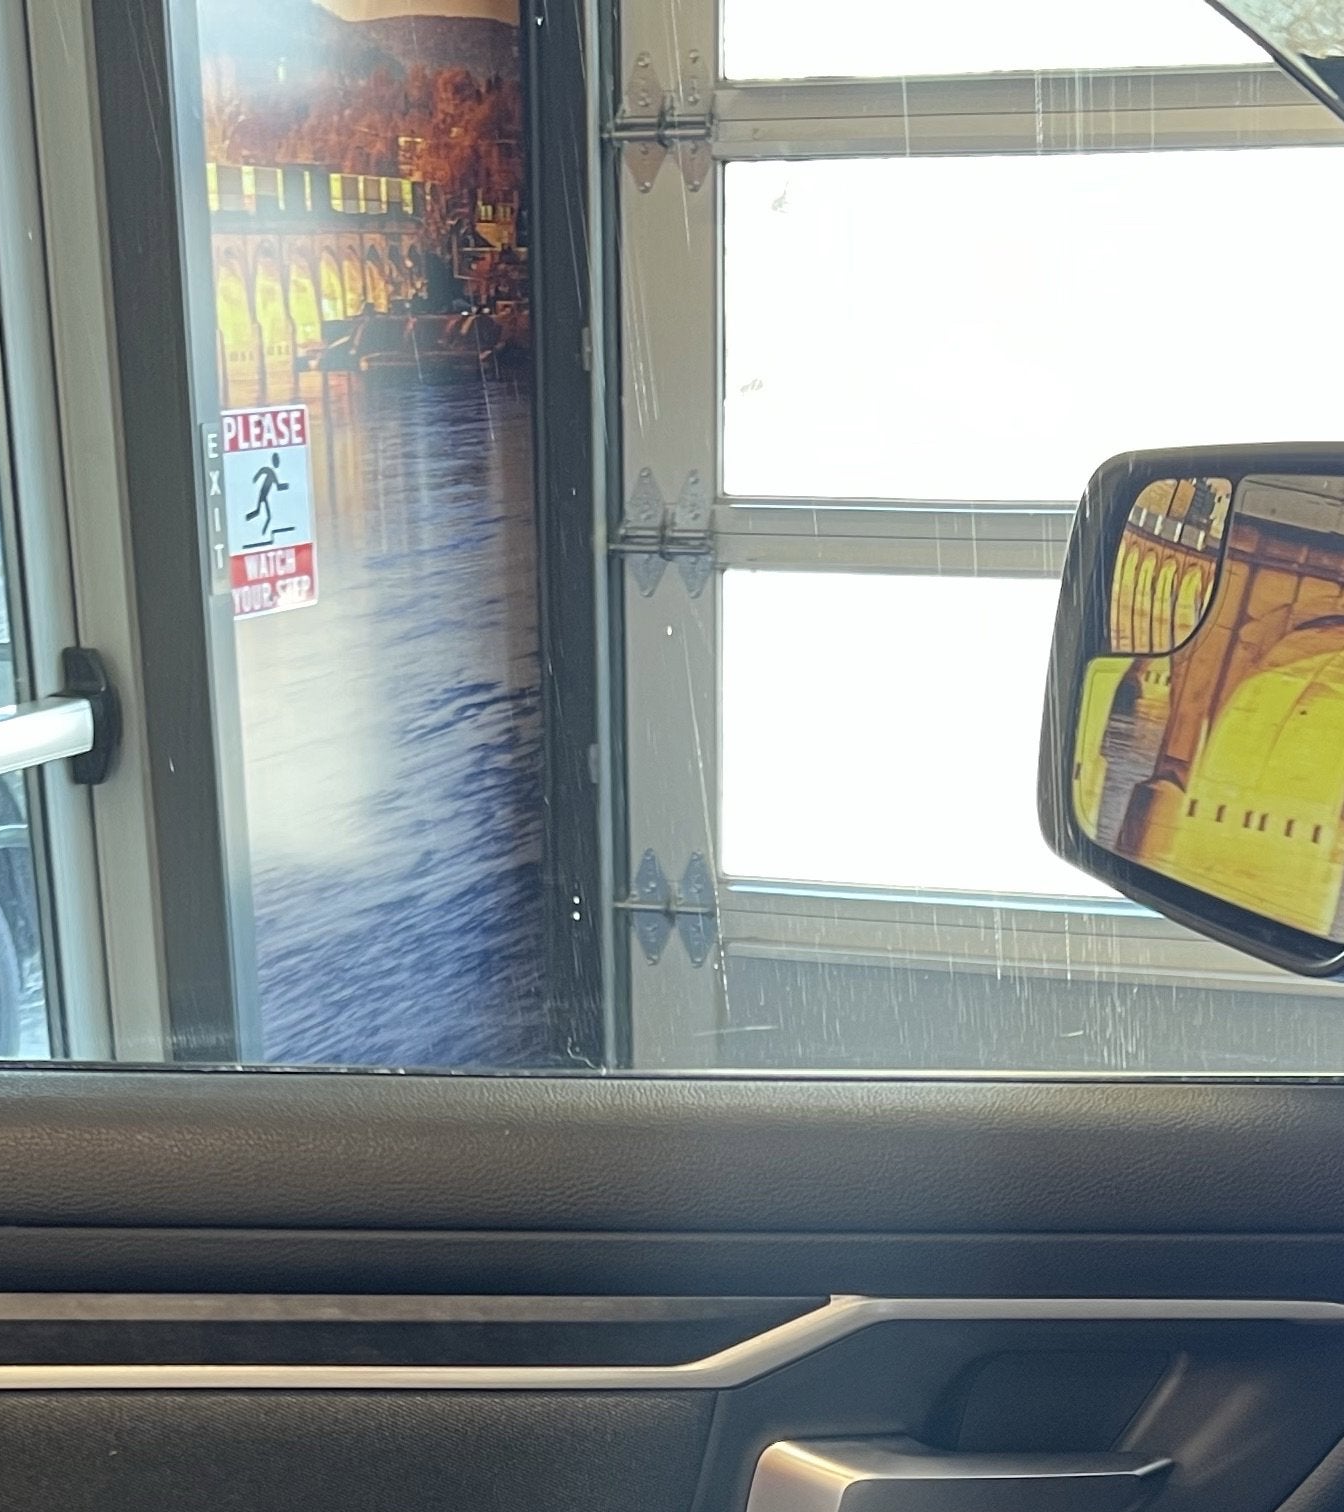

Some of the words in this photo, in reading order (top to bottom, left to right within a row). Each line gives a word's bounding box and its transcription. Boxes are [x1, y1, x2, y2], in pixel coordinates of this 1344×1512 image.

[222, 410, 304, 451] PLEASE
[207, 433, 225, 569] EXIT
[244, 548, 296, 581] WATCH
